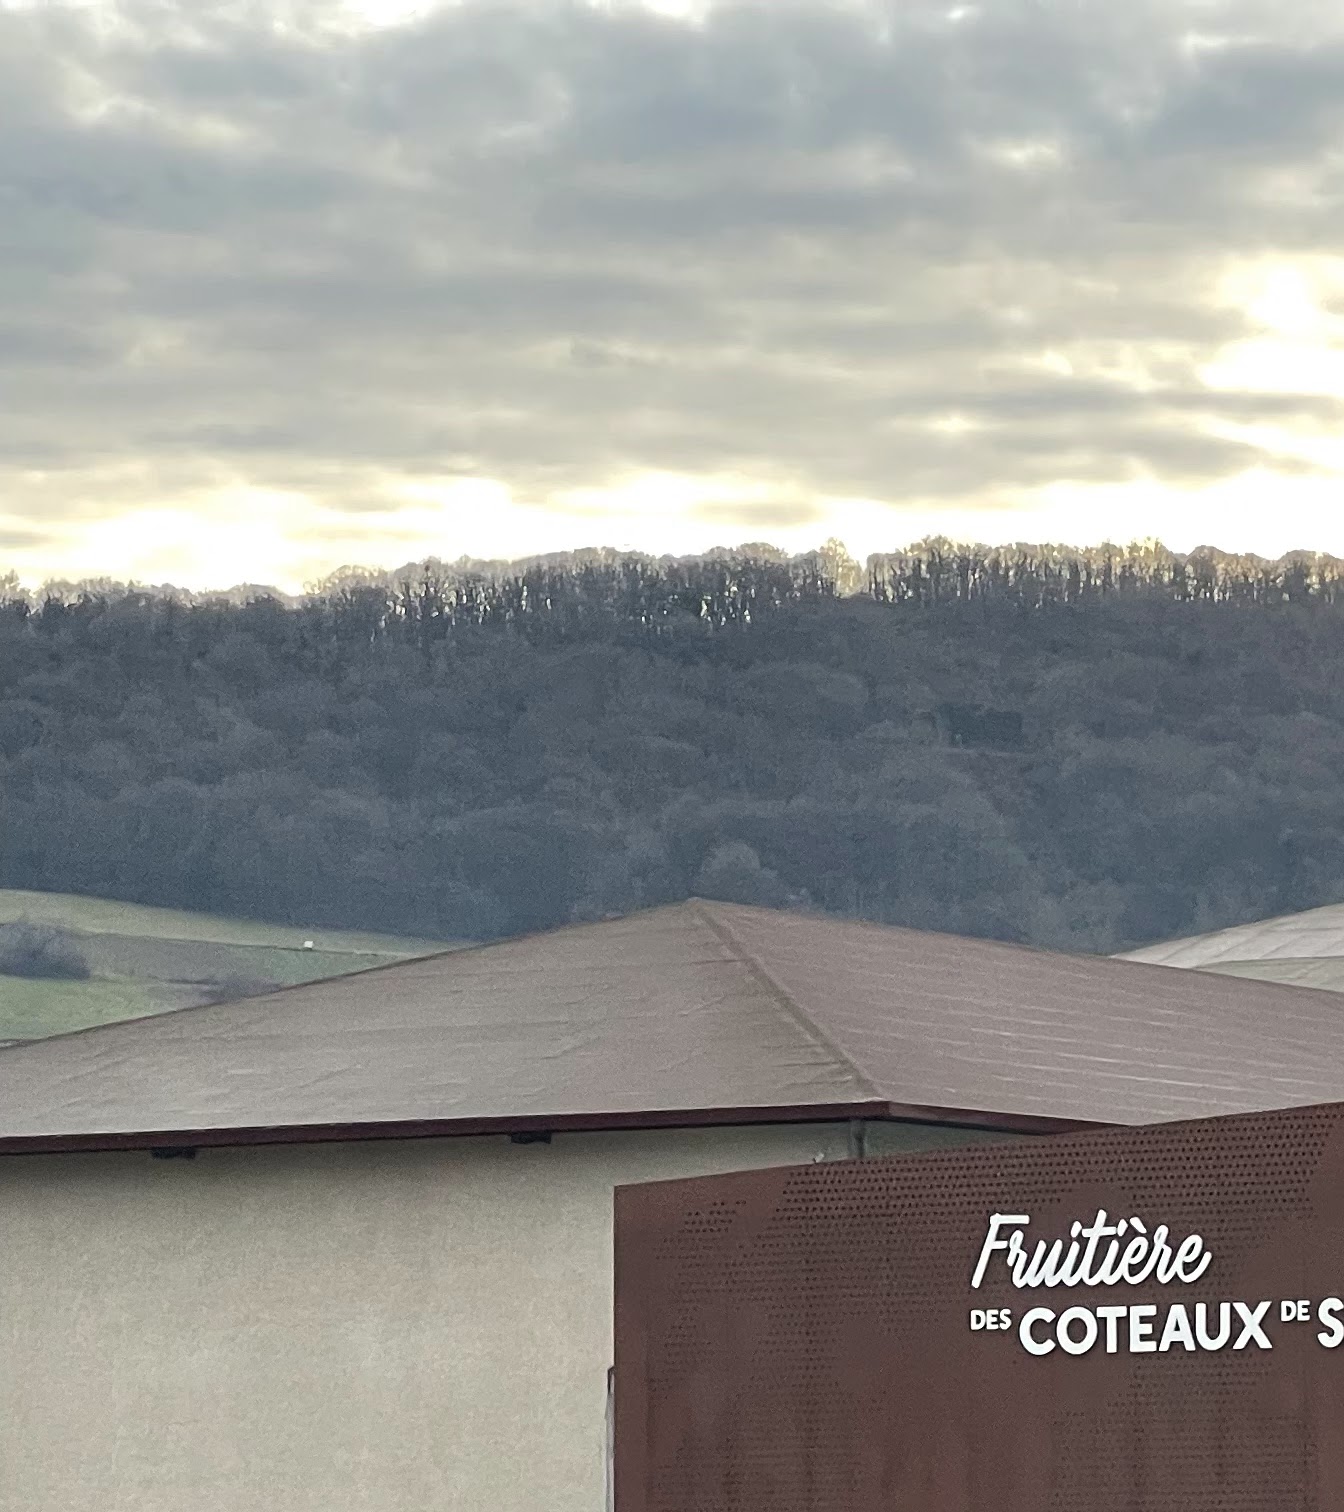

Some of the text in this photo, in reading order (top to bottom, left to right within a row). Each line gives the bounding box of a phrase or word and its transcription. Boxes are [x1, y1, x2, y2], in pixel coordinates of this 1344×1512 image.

[970, 1208, 1212, 1289] Fruitière
[970, 1308, 1012, 1331] DES
[1018, 1301, 1273, 1356] COTEAUX
[1280, 1300, 1311, 1323] DE
